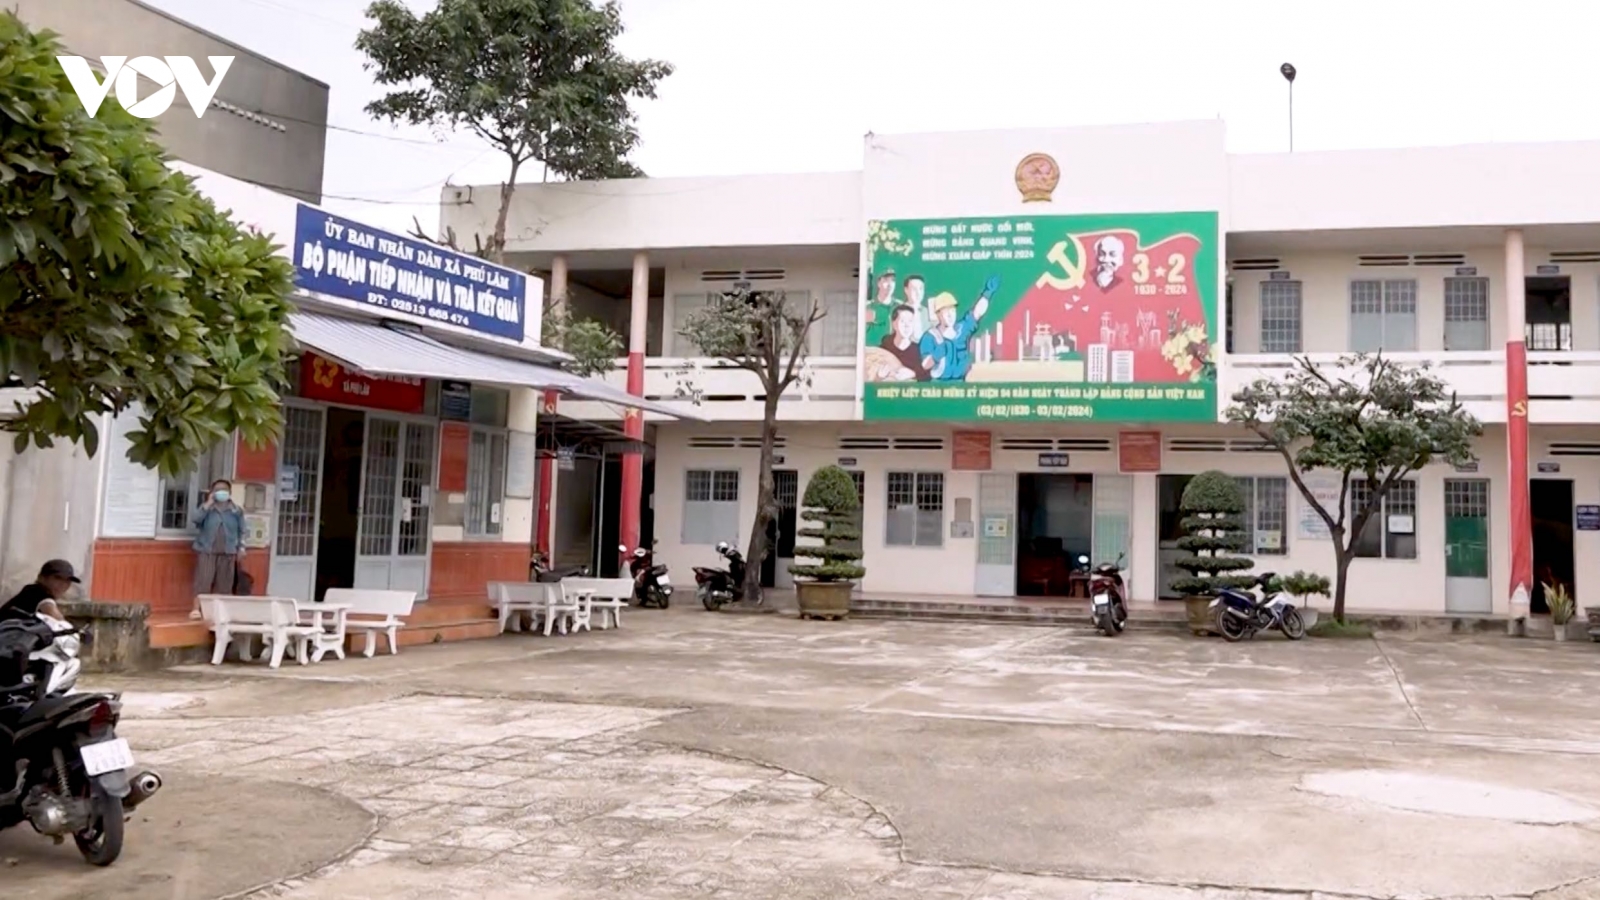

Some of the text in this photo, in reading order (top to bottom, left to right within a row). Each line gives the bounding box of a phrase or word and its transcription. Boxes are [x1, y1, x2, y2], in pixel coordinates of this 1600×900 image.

[951, 221, 967, 233] ĐẤT
[952, 235, 974, 247] ĐẢNG
[979, 237, 1007, 247] QUANG
[325, 216, 509, 290] ỦY BAN NHÂN DÂN XÃ PHÚ LÂM
[948, 250, 971, 260] XUÂN
[972, 249, 992, 260] GIÁP
[1014, 250, 1034, 259] 2024
[1132, 253, 1186, 284] 3 2
[302, 240, 519, 324] BỘ PHẬN TIẾP NHẬN VÀ TRẢ KẾT QUẢ
[1134, 284, 1157, 295] 1930
[1164, 284, 1188, 295] 2024
[450, 313, 470, 326] 474
[902, 387, 920, 399] LIỆT
[921, 386, 941, 398] CHÀO
[1031, 386, 1051, 398] NGÀY
[1053, 386, 1081, 399] THÀNH
[1082, 387, 1099, 400] LẬP
[1100, 385, 1122, 399] ĐẢNG
[1123, 388, 1145, 400] CỘNG
[1146, 385, 1163, 399] SẢN
[1165, 388, 1184, 400] VIỆT
[1186, 389, 1205, 399] NAM
